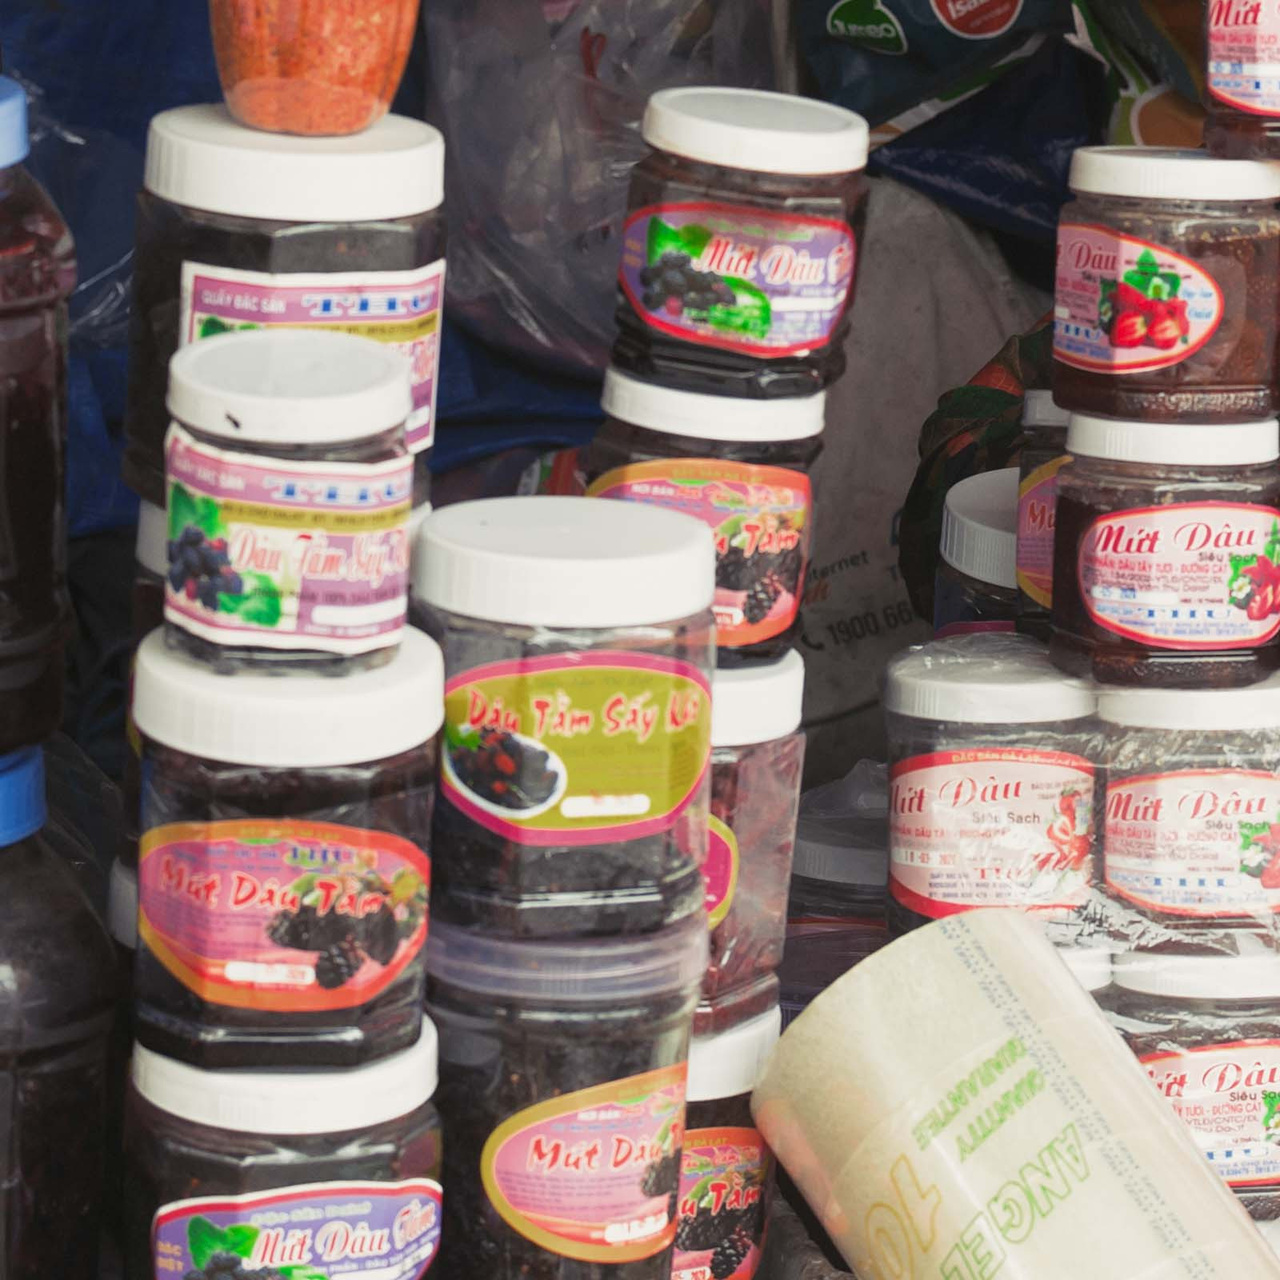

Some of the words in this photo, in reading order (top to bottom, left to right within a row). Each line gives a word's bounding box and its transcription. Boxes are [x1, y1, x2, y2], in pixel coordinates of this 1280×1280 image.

[1210, 0, 1261, 27] Mứt
[1069, 240, 1117, 270] Dâu
[301, 285, 436, 317] THU
[1094, 524, 1159, 554] Mứt
[1174, 522, 1255, 551] Dâu
[1199, 552, 1224, 562] Siêu
[827, 612, 880, 645] 1900
[467, 688, 520, 734] Dâu
[939, 776, 1022, 807] Dâu
[1107, 792, 1163, 821] Mứt
[1178, 791, 1267, 819] Dâu
[1205, 821, 1233, 831] Siêu
[231, 873, 299, 912] Dâu
[1229, 1092, 1257, 1102] Siêu
[314, 1220, 391, 1262] Dâu
